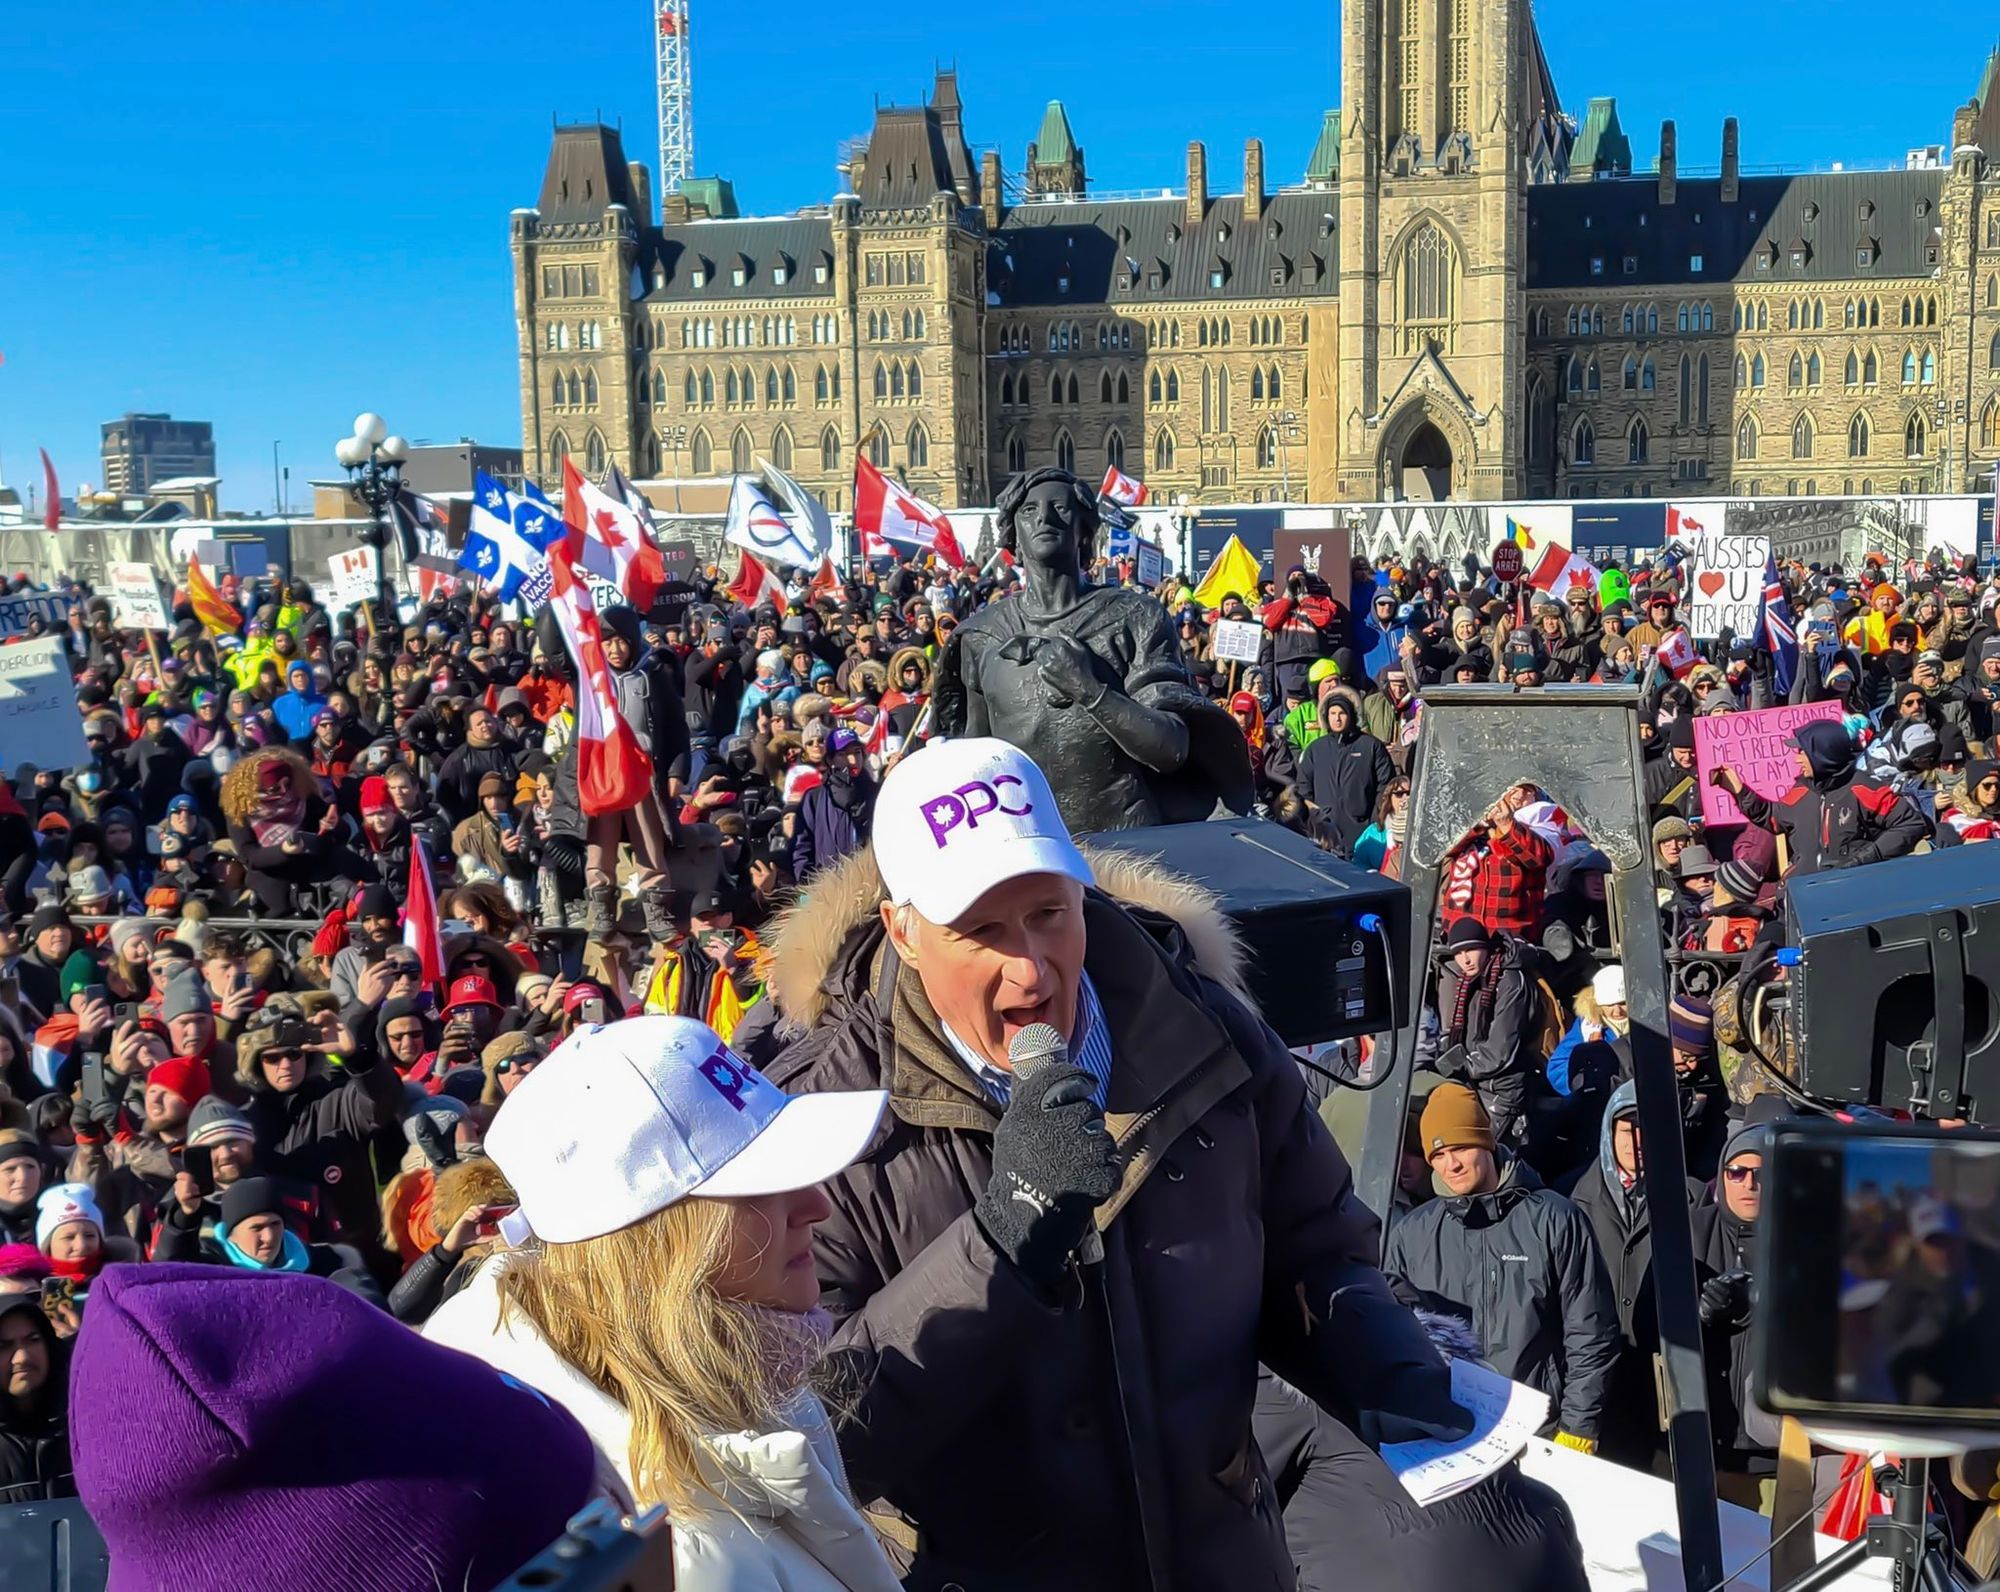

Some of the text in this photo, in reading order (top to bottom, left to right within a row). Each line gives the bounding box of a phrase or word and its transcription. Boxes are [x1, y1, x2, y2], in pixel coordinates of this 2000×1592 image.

[1495, 559, 1519, 571] ARRÊT
[1498, 548, 1518, 559] STOP
[1694, 537, 1765, 570] AUSSIES
[1729, 571, 1748, 602] U
[1704, 717, 1730, 740] NO
[1734, 713, 1770, 737] ONE
[1712, 734, 1797, 764] ME FREED
[1750, 762, 1761, 784] I
[1767, 759, 1792, 781] AM
[920, 775, 1033, 849] PPC
